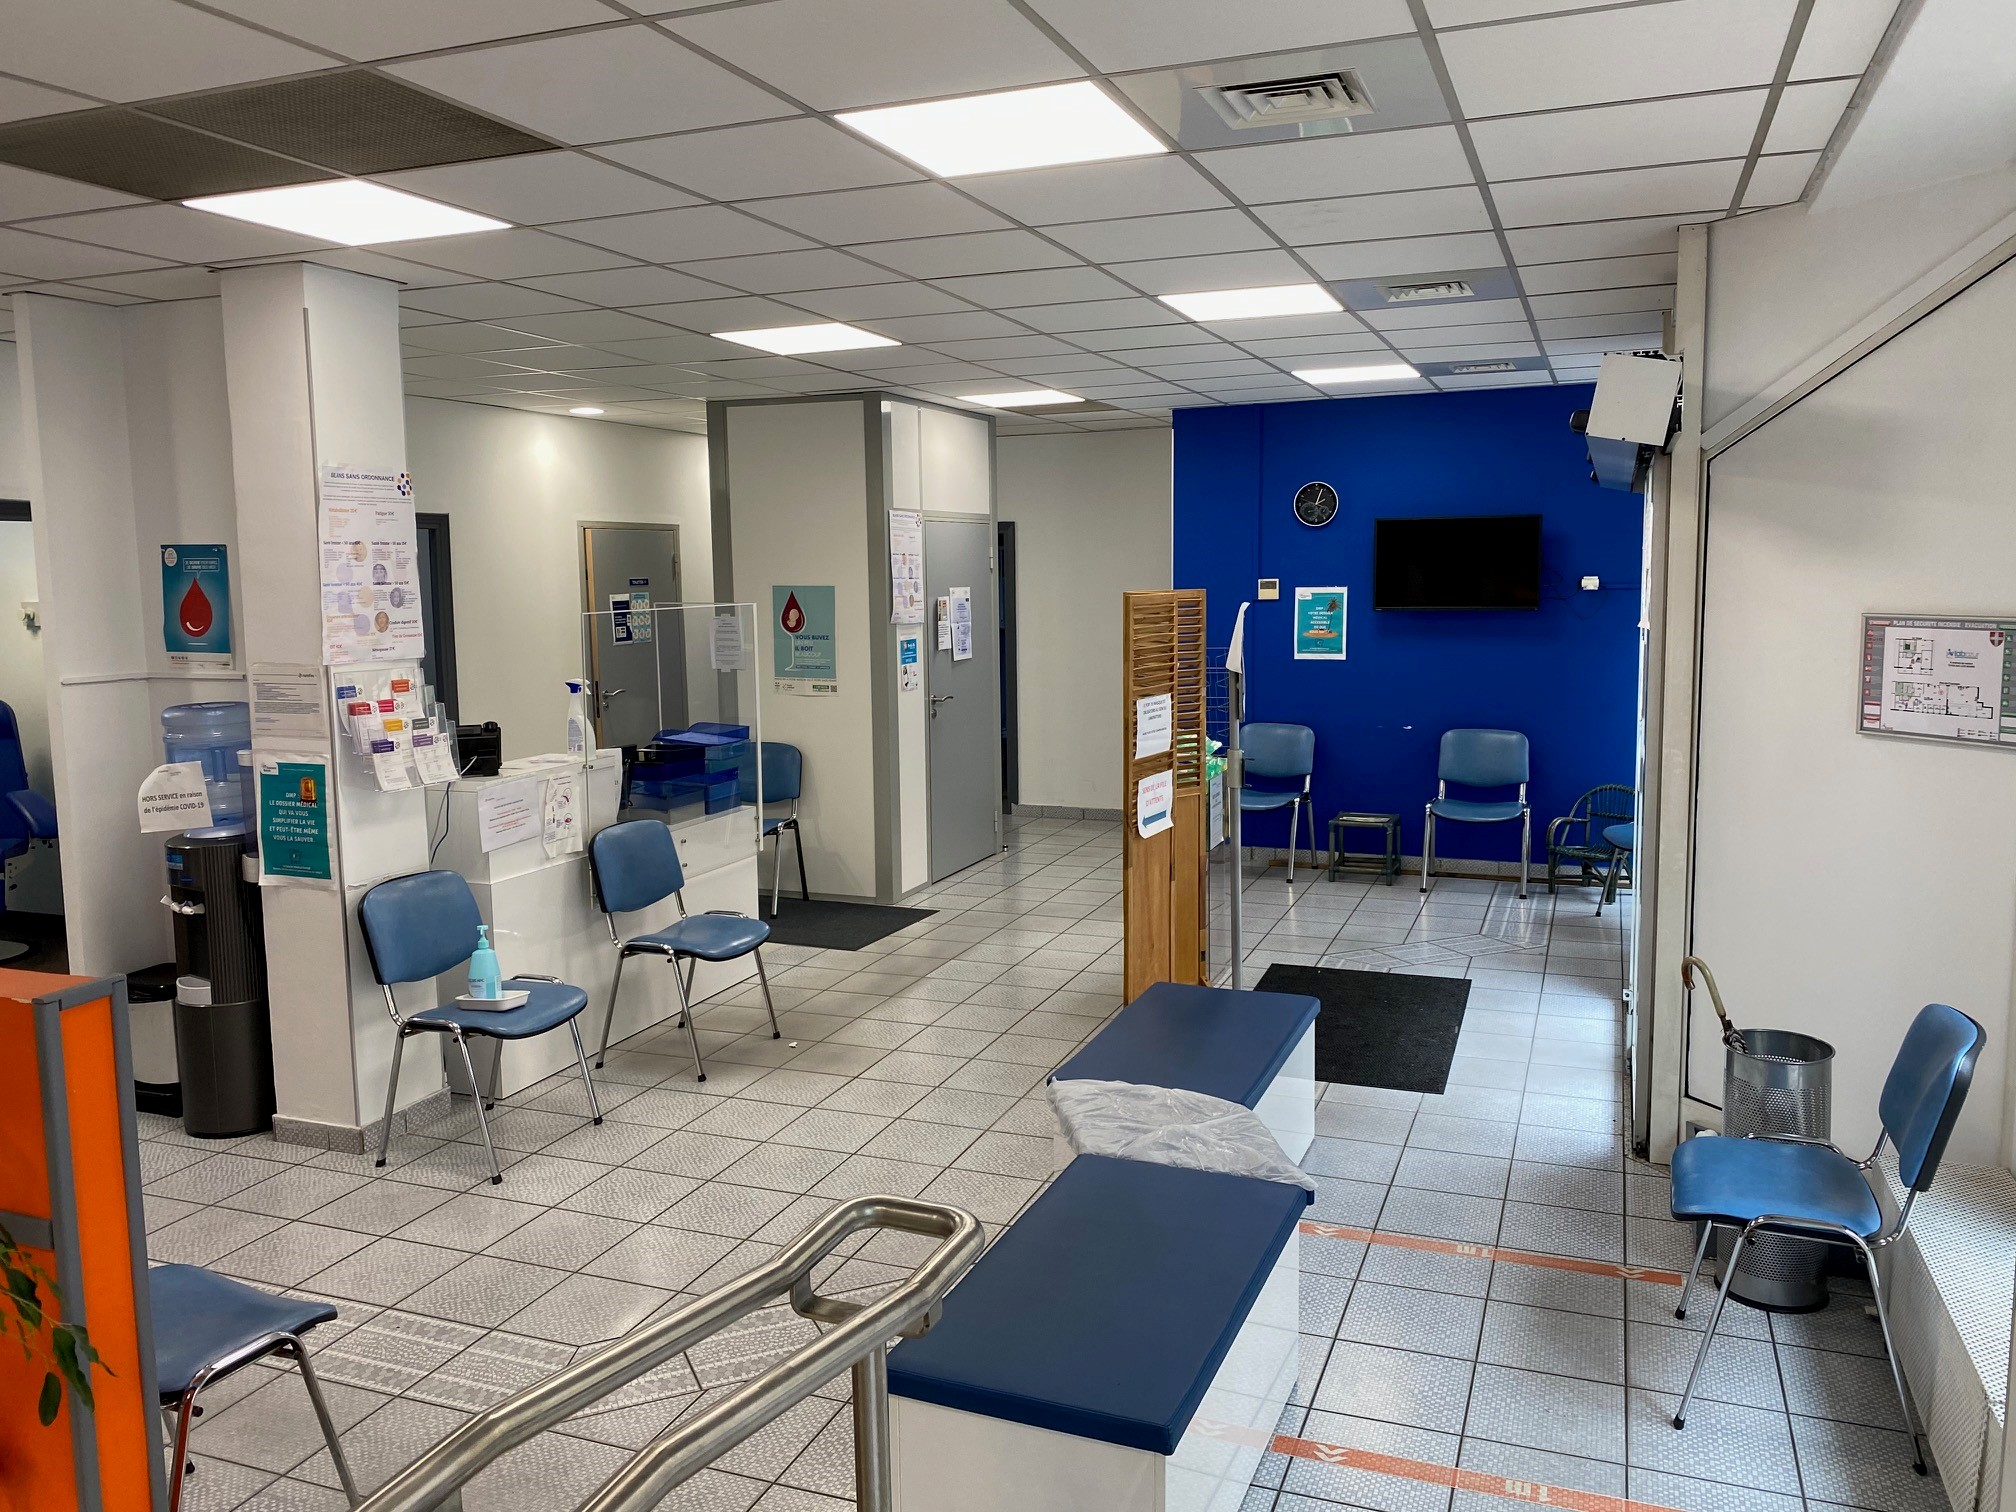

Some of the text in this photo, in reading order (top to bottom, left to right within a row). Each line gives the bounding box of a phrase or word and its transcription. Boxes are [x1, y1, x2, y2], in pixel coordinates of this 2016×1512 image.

[361, 474, 394, 482] ORDONNANCE
[142, 795, 157, 803] HORS
[158, 792, 179, 801] SERVICE
[152, 804, 179, 813] l'épidémie
[180, 802, 205, 811] COVID-19
[296, 801, 318, 809] MÉDICAL
[272, 817, 298, 825] SIMPLIFIER
[303, 827, 319, 835] MÊME
